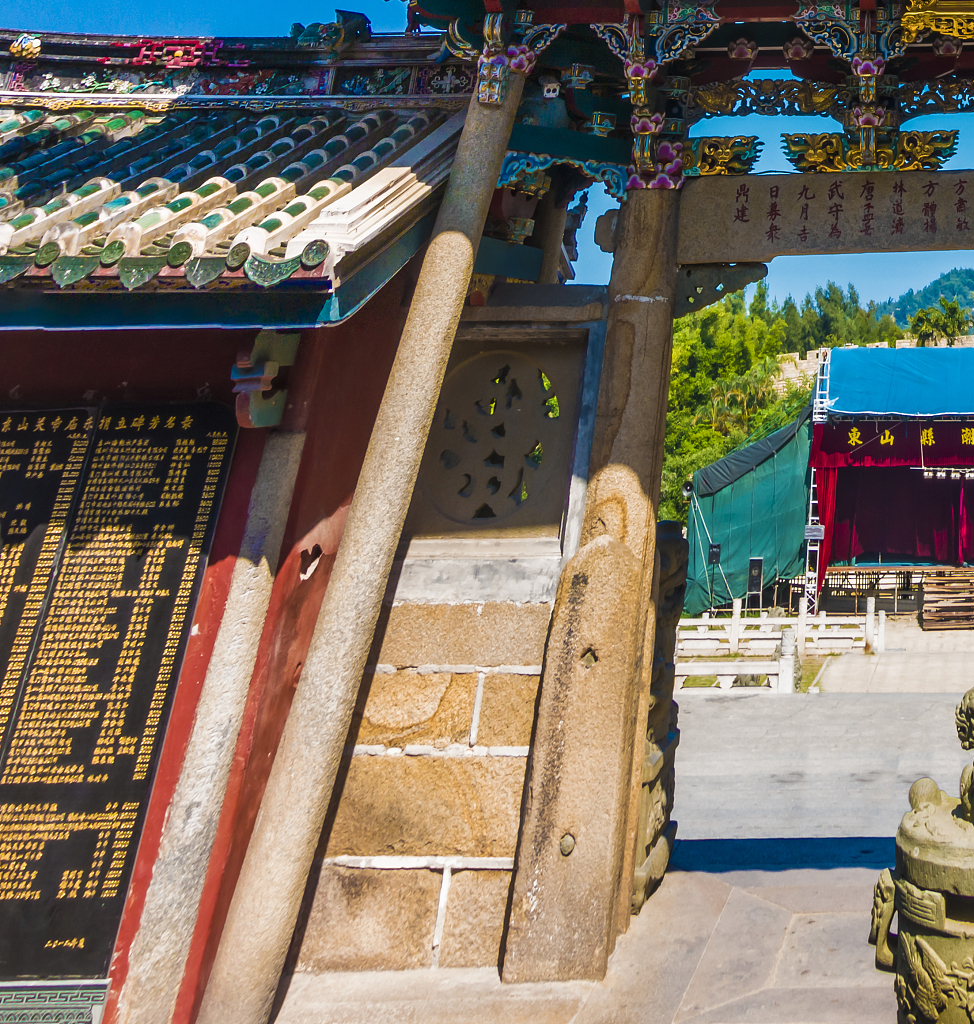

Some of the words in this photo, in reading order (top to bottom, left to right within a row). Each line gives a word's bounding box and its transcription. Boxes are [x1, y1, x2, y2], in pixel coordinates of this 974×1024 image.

[798, 185, 815, 242] 九月吉
[891, 179, 906, 235] 林道濟
